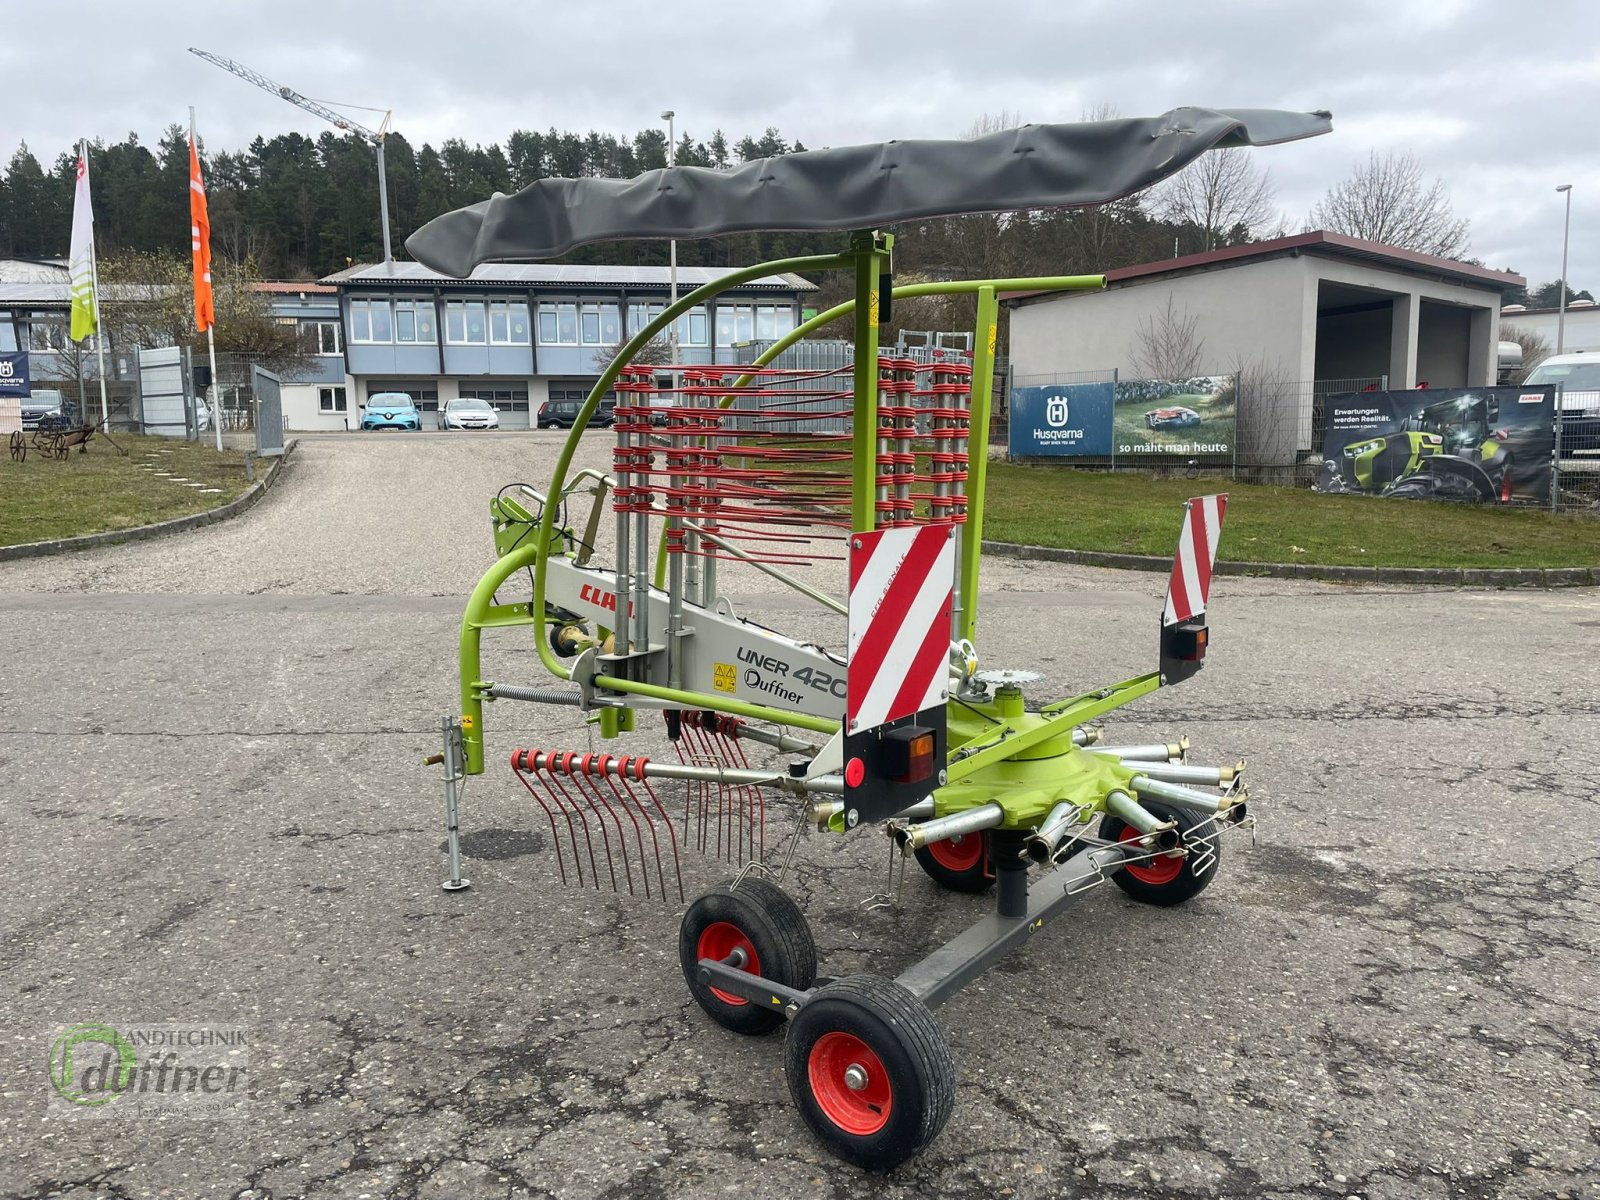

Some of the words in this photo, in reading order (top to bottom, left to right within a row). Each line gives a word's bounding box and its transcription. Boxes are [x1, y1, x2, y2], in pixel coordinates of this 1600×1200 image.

[1334, 408, 1379, 416] Erwartungen
[1333, 415, 1360, 423] werden
[1033, 428, 1083, 440] Husqvarna
[1119, 444, 1130, 452] so
[1134, 441, 1163, 452] mäht
[1165, 444, 1190, 452] man
[1193, 441, 1228, 452] heute
[737, 646, 790, 677] LINER
[793, 666, 848, 699] 420
[744, 668, 804, 704] Duffner
